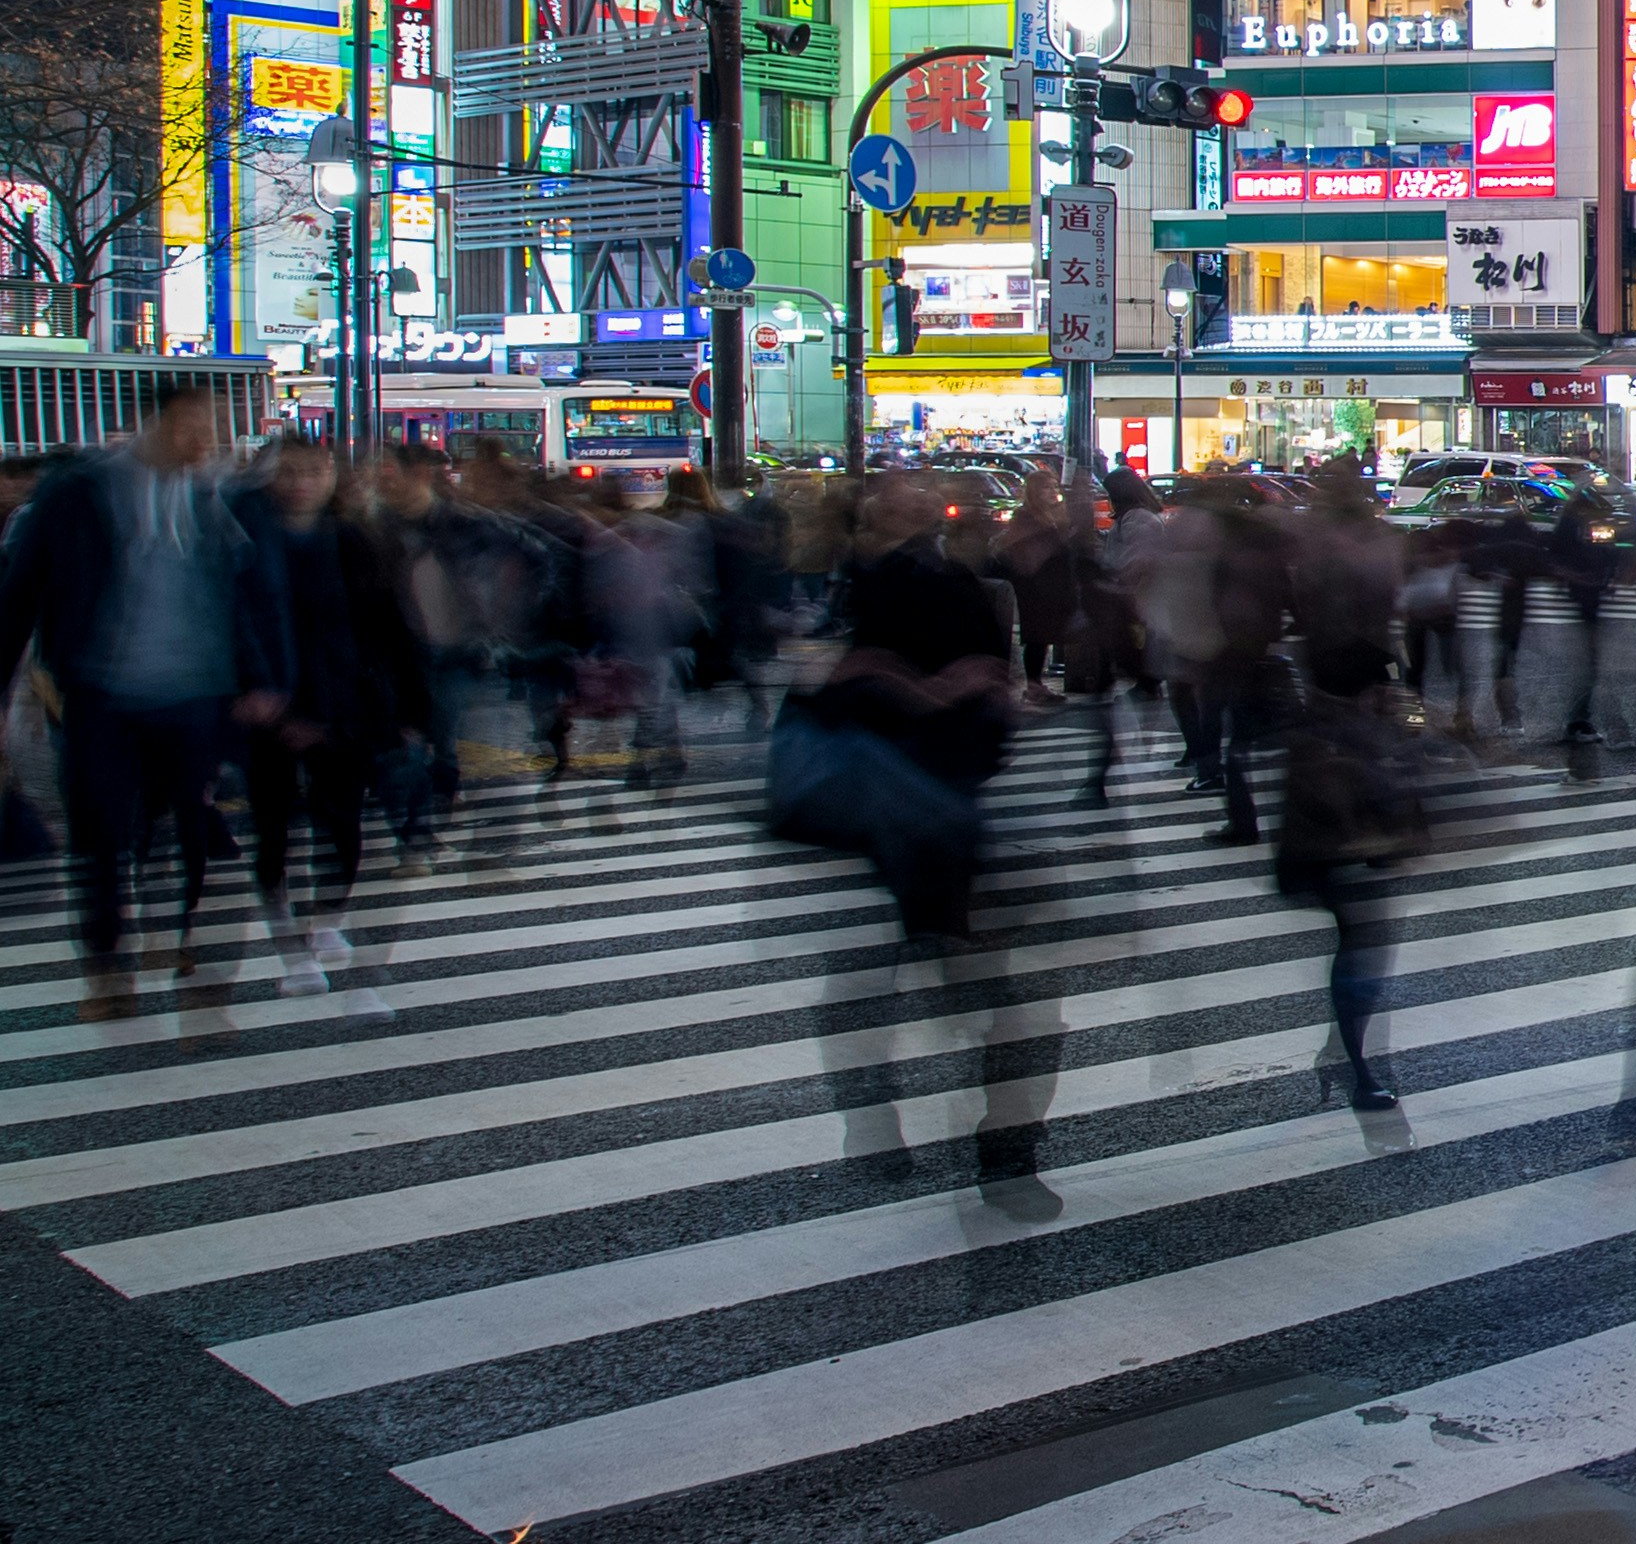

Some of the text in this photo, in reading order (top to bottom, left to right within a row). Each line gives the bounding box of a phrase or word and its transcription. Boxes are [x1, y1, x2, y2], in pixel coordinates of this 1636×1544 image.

[1018, 11, 1034, 56] Shibuya
[1241, 12, 1460, 57] Euphoria
[266, 64, 332, 111] 薬
[1479, 103, 1553, 155] JTB
[1091, 204, 1111, 289] Dougen-zaka
[1452, 226, 1501, 246] うなぎ
[1058, 202, 1092, 344] 道玄坂
[1472, 250, 1549, 293] 松川
[1256, 379, 1293, 394] 渋谷
[1567, 380, 1597, 397] 松川
[606, 447, 633, 458] BUS
